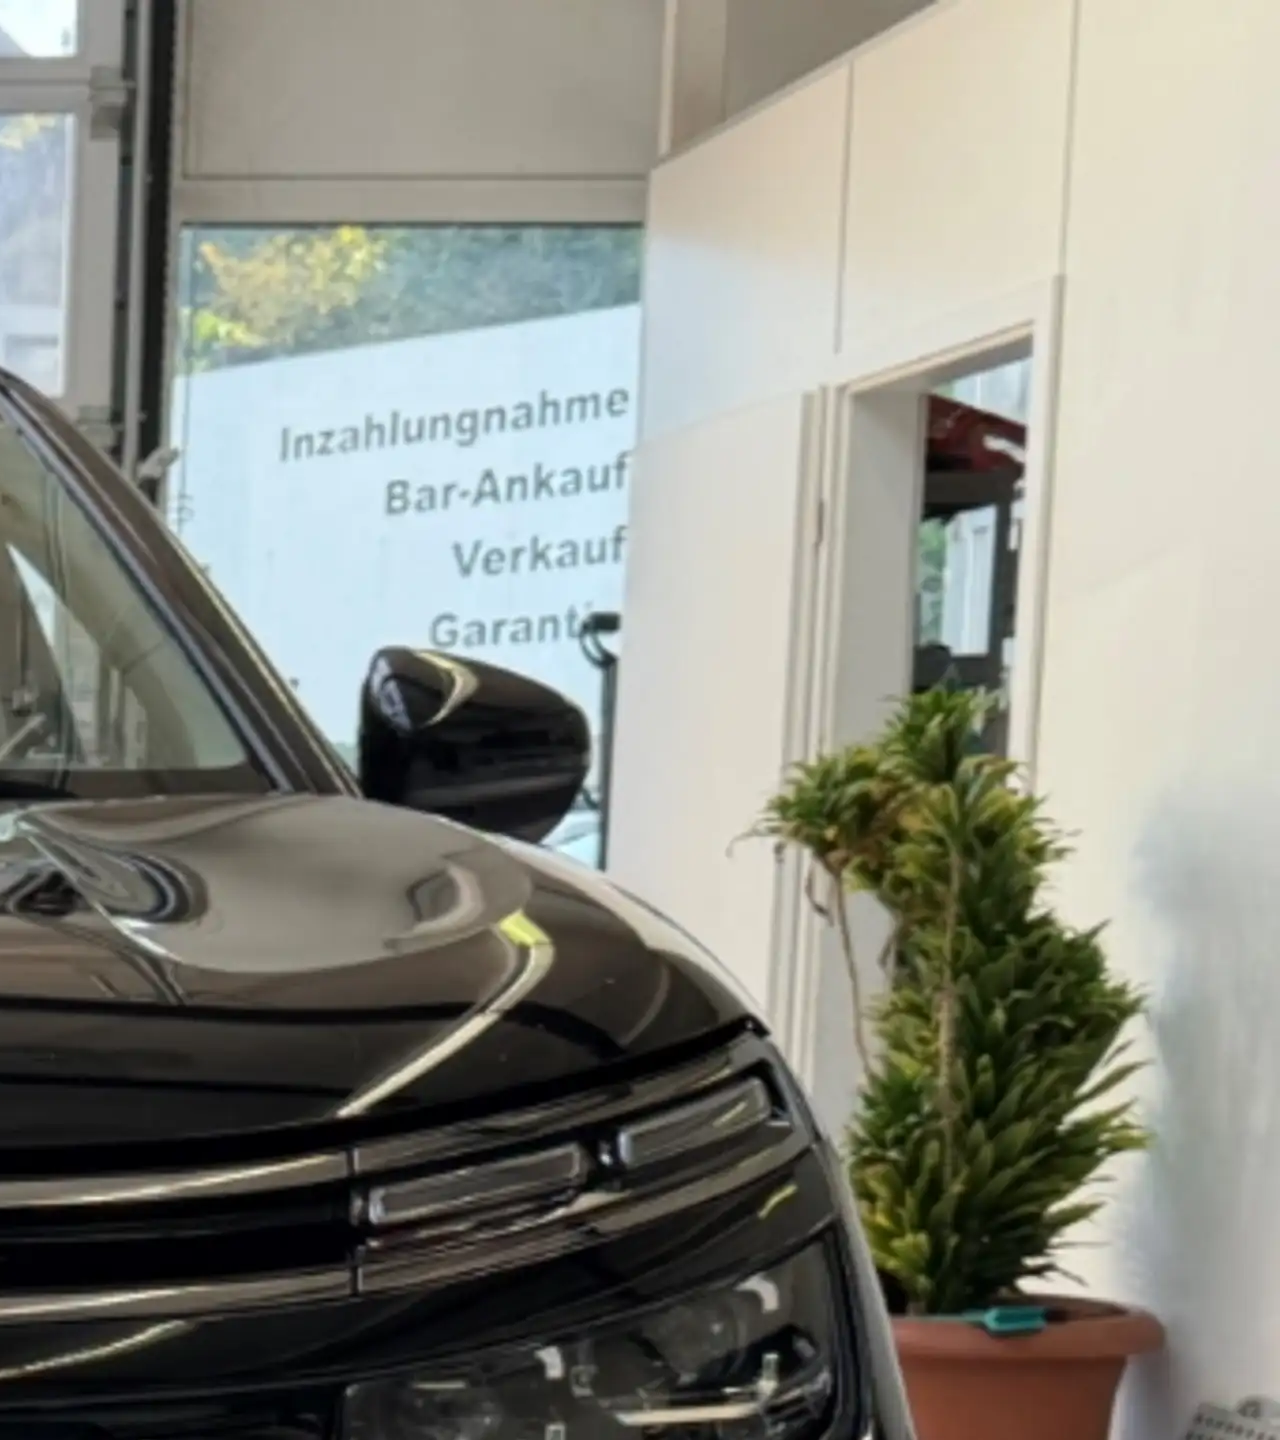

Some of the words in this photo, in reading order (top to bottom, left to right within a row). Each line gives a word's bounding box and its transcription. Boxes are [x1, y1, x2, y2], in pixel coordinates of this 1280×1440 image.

[279, 387, 630, 462] Inzahlungnahme
[385, 451, 630, 516] Bar-Ankauf
[452, 525, 628, 578] Verkauf
[428, 601, 593, 648] Garant
